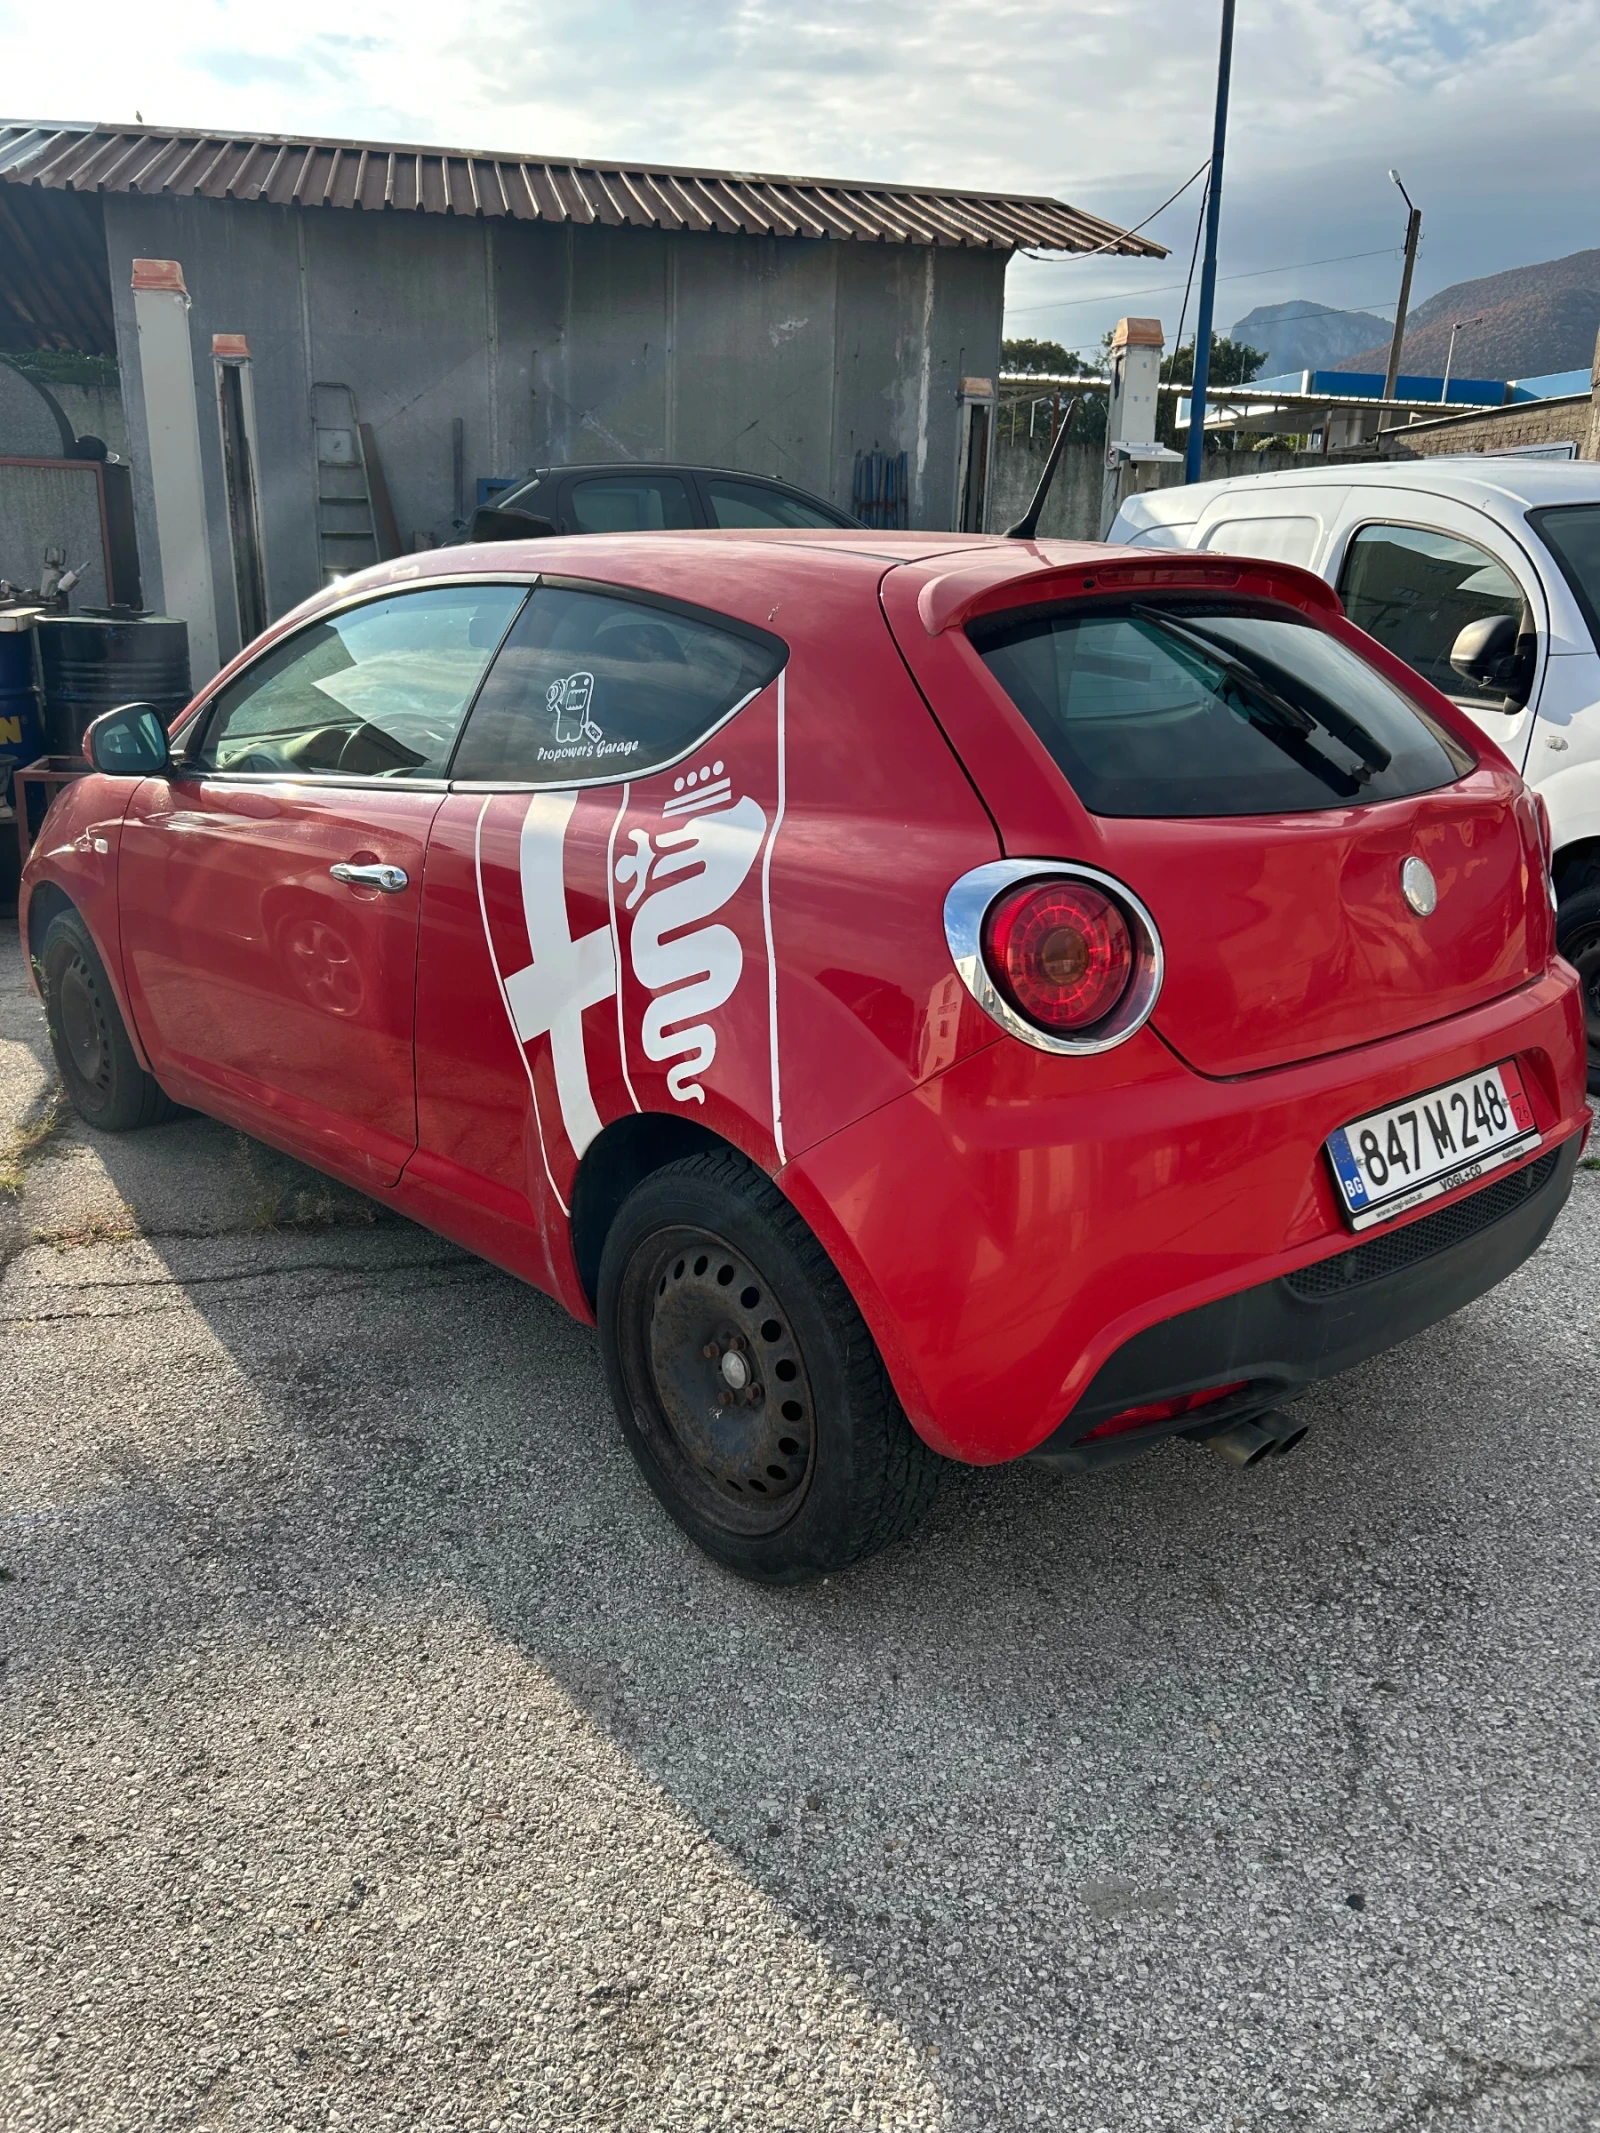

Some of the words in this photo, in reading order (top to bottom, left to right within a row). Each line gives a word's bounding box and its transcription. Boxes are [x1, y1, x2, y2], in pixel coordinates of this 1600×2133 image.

[537, 742, 593, 762] Propower's
[597, 741, 639, 757] Garage
[1360, 1111, 1421, 1186] 847
[1451, 1080, 1507, 1148] 248
[1345, 1177, 1364, 1197] BG
[1439, 1164, 1482, 1190] VOGL+CO
